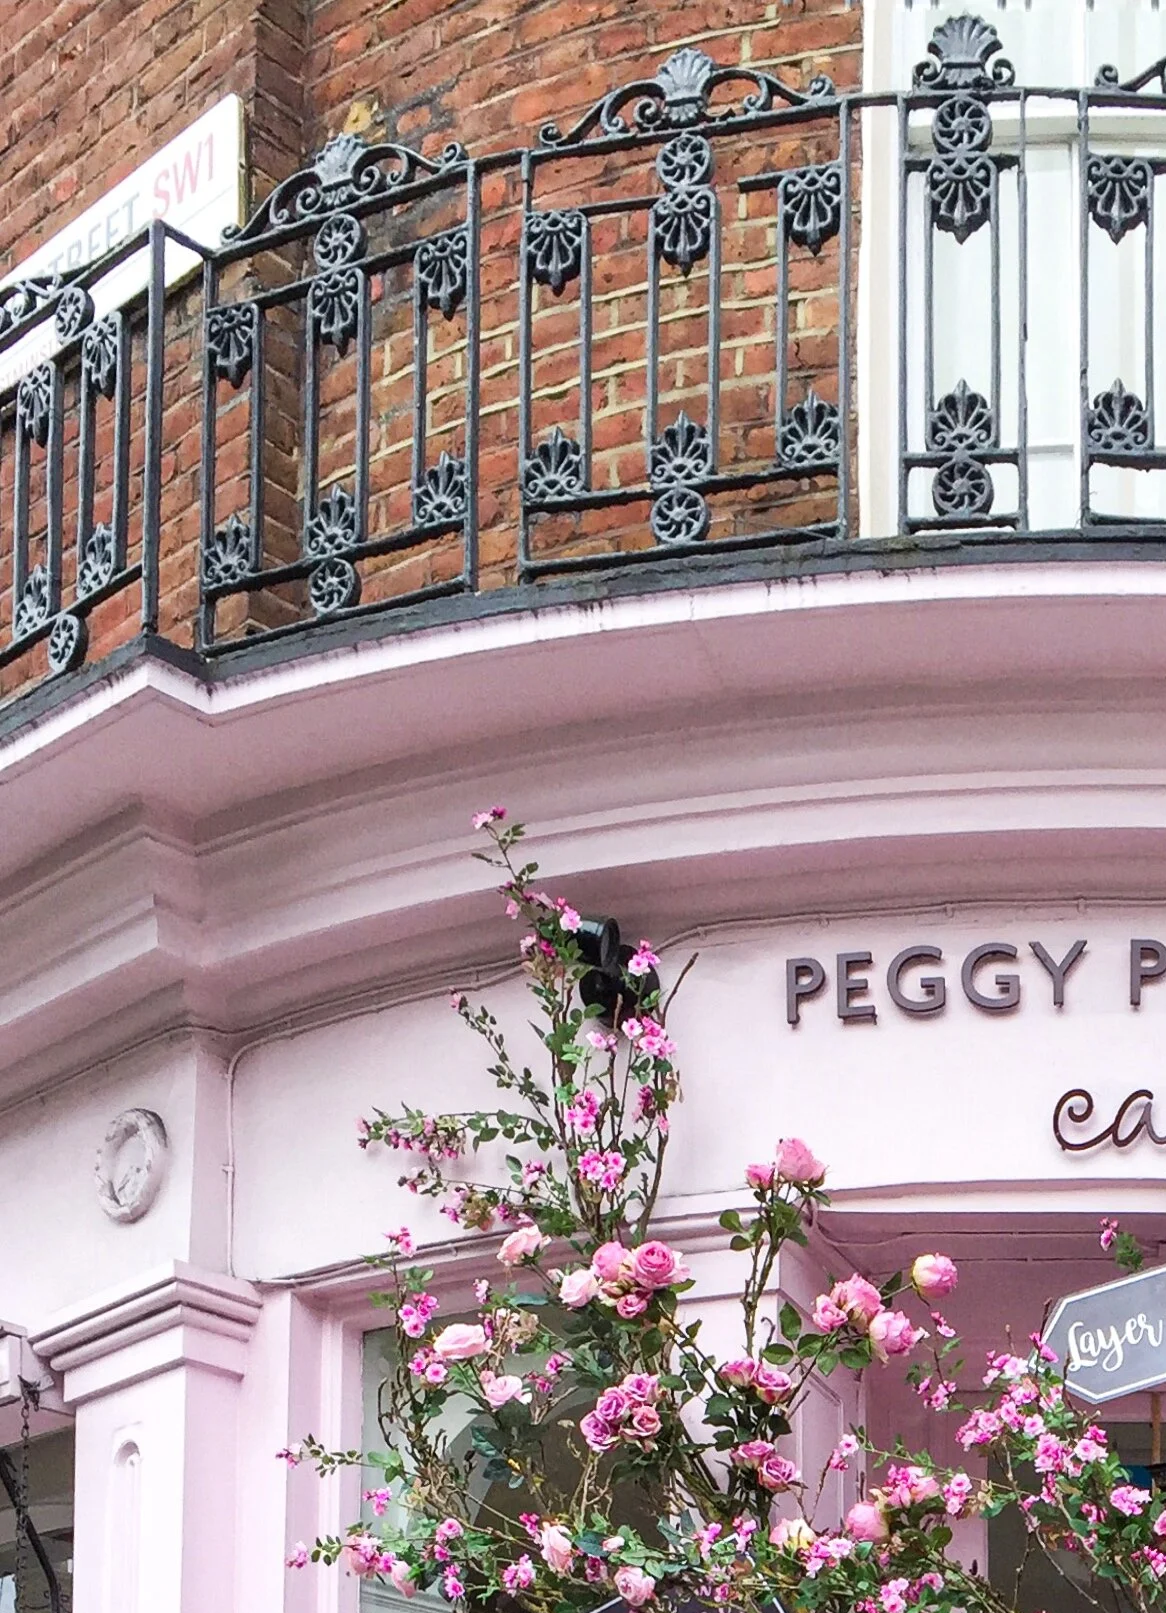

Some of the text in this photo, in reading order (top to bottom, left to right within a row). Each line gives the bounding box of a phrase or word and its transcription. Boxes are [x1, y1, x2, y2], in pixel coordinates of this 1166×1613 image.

[37, 133, 217, 277] TREET SW1
[786, 938, 1089, 1028] PEGGY
[1067, 1313, 1164, 1373] Layer
